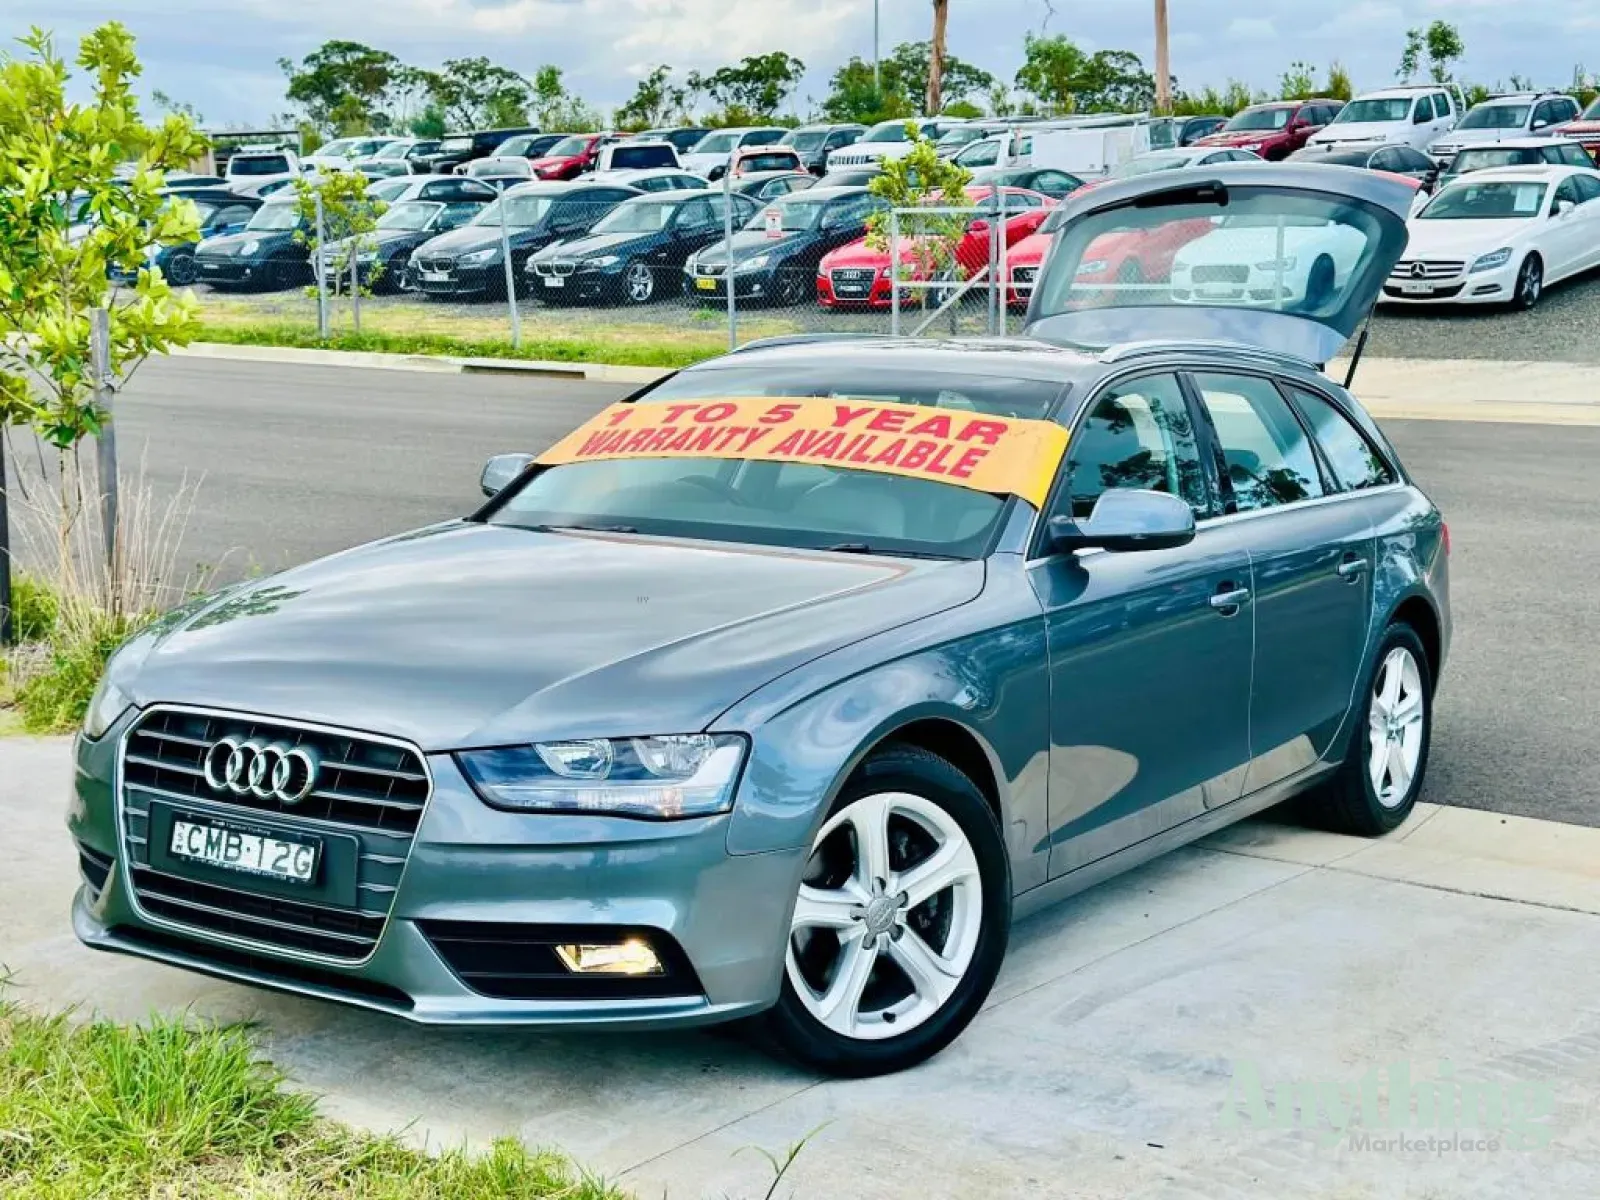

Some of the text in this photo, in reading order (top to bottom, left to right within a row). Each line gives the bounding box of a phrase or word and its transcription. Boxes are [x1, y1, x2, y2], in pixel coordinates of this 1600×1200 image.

[606, 402, 1009, 446] 1 TO 5 YEAR
[575, 426, 990, 479] WARRANTY AVAILABLE
